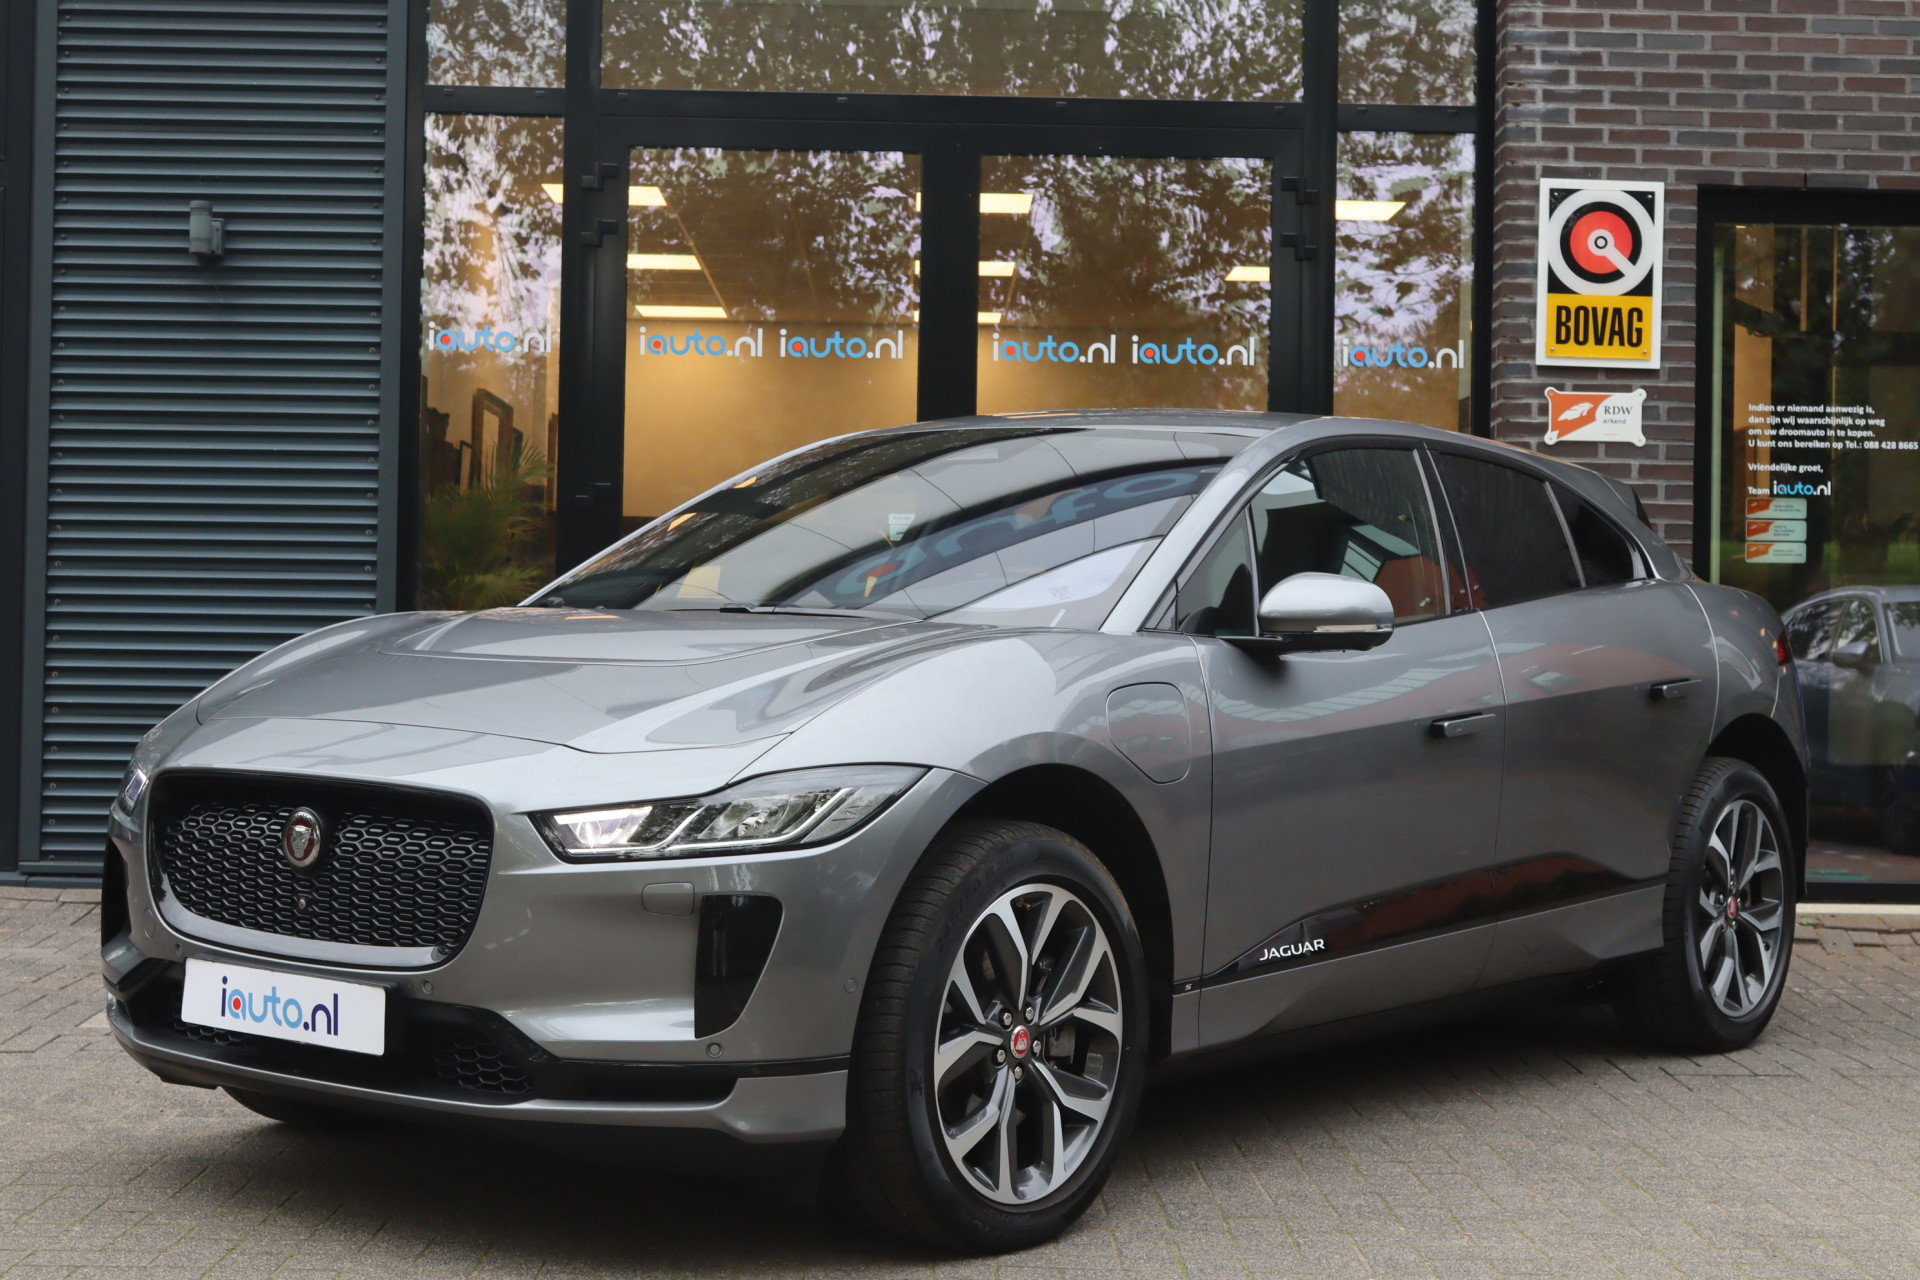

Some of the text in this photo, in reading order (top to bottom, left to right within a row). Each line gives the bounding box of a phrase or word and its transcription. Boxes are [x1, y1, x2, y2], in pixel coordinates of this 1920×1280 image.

[428, 321, 551, 354] iauto.nl
[1555, 305, 1643, 347] BOVAG
[639, 326, 762, 357] iauto.nl
[779, 328, 904, 359] iauto.nl
[992, 332, 1116, 364] iauto.nl
[1131, 335, 1255, 366] iauto.nl
[1342, 337, 1465, 369] iauto.nl
[1604, 405, 1633, 415] RDW
[1748, 404, 1775, 412] Indien
[1787, 404, 1824, 413] niemand
[1826, 405, 1864, 415] aanwezig
[1865, 405, 1875, 415] is,
[1766, 416, 1780, 425] zijn
[1782, 416, 1795, 425] wij
[1796, 416, 1853, 426] waarschijnlijk
[1855, 418, 1866, 427] op
[1868, 418, 1885, 427] weg
[1748, 439, 1755, 447] U
[1757, 439, 1776, 448] kunt
[1794, 439, 1830, 448] bereiken
[1832, 441, 1843, 450] op
[1863, 441, 1879, 449] 088
[1881, 441, 1896, 450] 428
[1898, 441, 1918, 450] 8665
[1764, 428, 1777, 436] uw
[1779, 427, 1825, 436] droomauto
[1826, 428, 1835, 436] in
[1836, 429, 1845, 437] te
[1847, 428, 1875, 438] kopen.
[1748, 463, 1823, 473] Vriendelijke groet,
[1747, 480, 1832, 496] Team iauto.nl
[1259, 938, 1325, 961] JAGUAR
[220, 975, 339, 1036] iauto.nl
